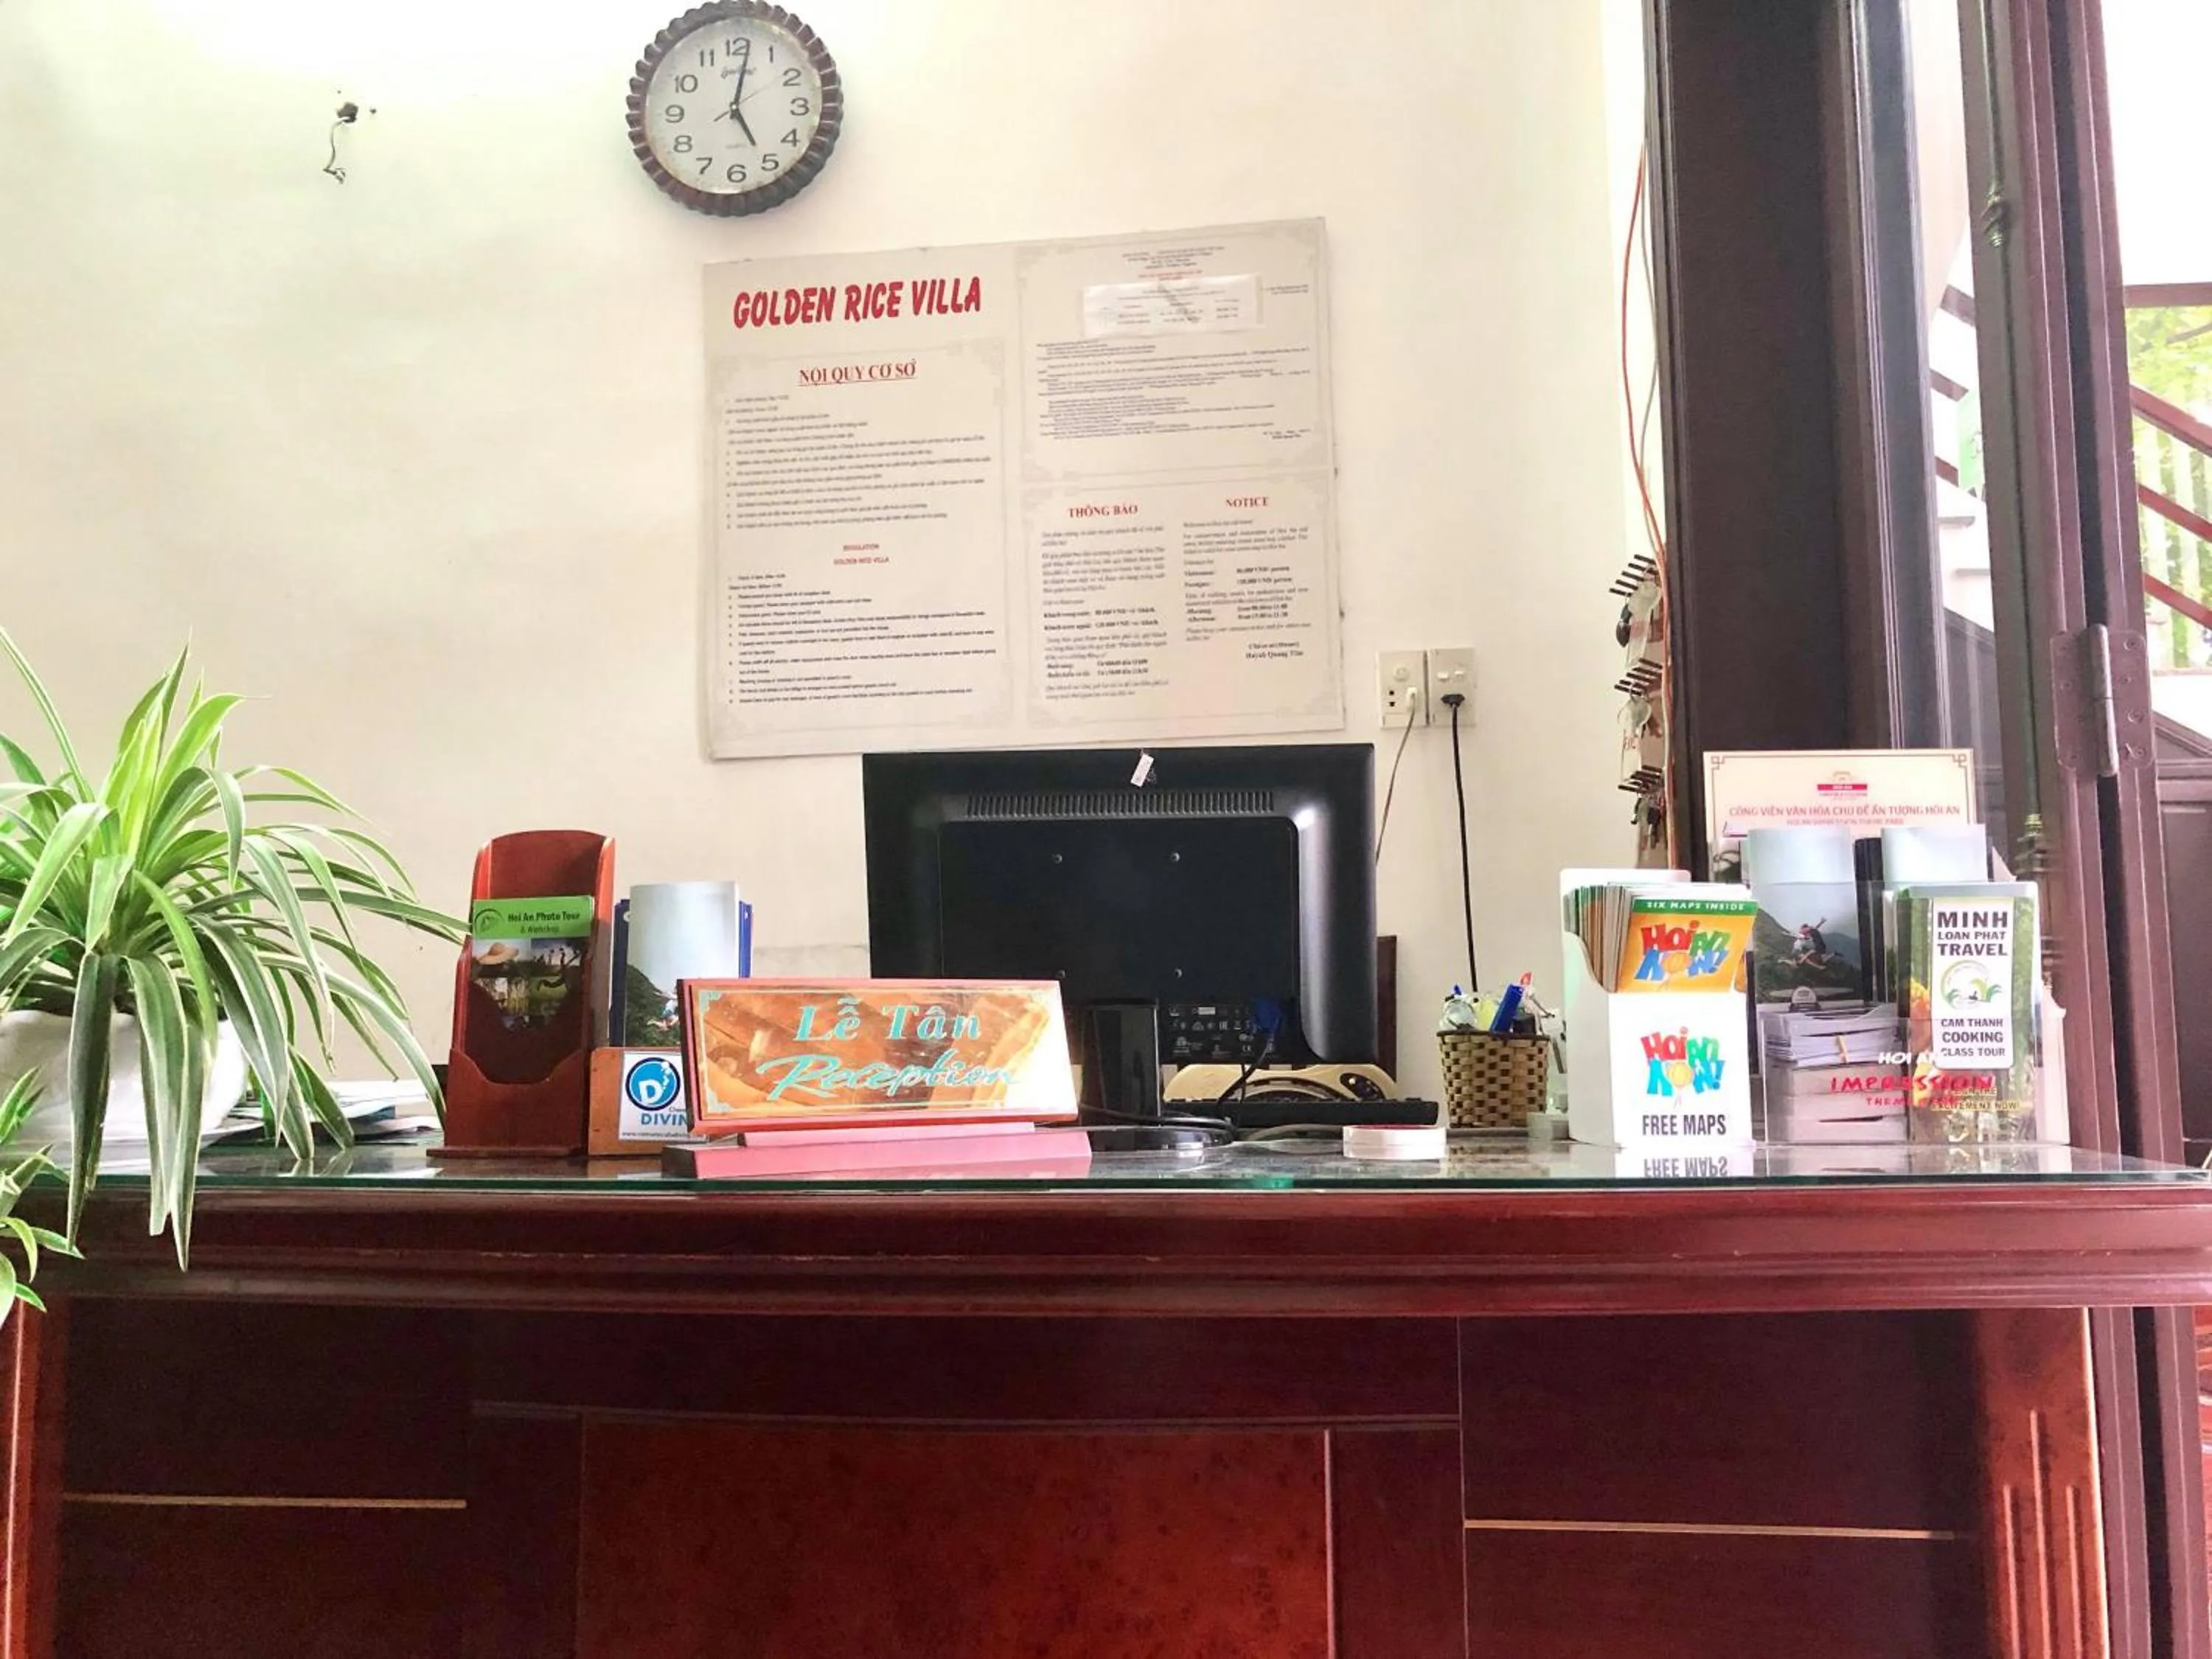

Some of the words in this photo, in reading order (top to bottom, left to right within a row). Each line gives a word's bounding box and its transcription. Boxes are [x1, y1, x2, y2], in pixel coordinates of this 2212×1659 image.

[726, 38, 751, 57] 12
[768, 45, 774, 63] 1
[700, 49, 715, 67] 11
[675, 74, 698, 94] 10
[782, 68, 801, 87] 2
[665, 105, 685, 124] 9
[790, 97, 810, 116] 3
[673, 135, 693, 153] 8
[780, 128, 801, 147] 4
[696, 157, 713, 175] 7
[761, 153, 779, 172] 5
[726, 164, 747, 183] 6
[734, 285, 837, 329] GOLDEN
[844, 281, 904, 323] RICE
[911, 276, 981, 316] VILLA
[832, 365, 865, 384] QUY
[869, 363, 892, 380] CƠ
[895, 358, 917, 378] SỞ
[1069, 503, 1110, 518] THÔNG
[1225, 496, 1269, 508] NOTICE
[1646, 902, 1666, 910] SIX
[1670, 902, 1701, 910] MAPS
[1705, 902, 1745, 911] INSIDE
[536, 911, 560, 921] Photo
[562, 911, 580, 921] Tour
[1937, 911, 2008, 928] MINH
[1938, 931, 1970, 941] LOAN
[1974, 931, 2007, 940] PHAT
[1937, 943, 2008, 956] TRAVEL
[793, 998, 862, 1042] Lễ
[882, 1003, 983, 1041] Tân
[1941, 1018, 1965, 1028] CAM
[1968, 1018, 2004, 1028] THANH
[1942, 1031, 2004, 1043] COOKING
[1879, 1051, 1911, 1065] HOI
[1941, 1047, 1975, 1057] CLASS
[1978, 1047, 2006, 1057] TOUR
[756, 1048, 1018, 1102] Reception
[641, 1113, 687, 1125] DIVIN
[1642, 1114, 1678, 1136] FREE
[1683, 1113, 1727, 1135] MAPS
